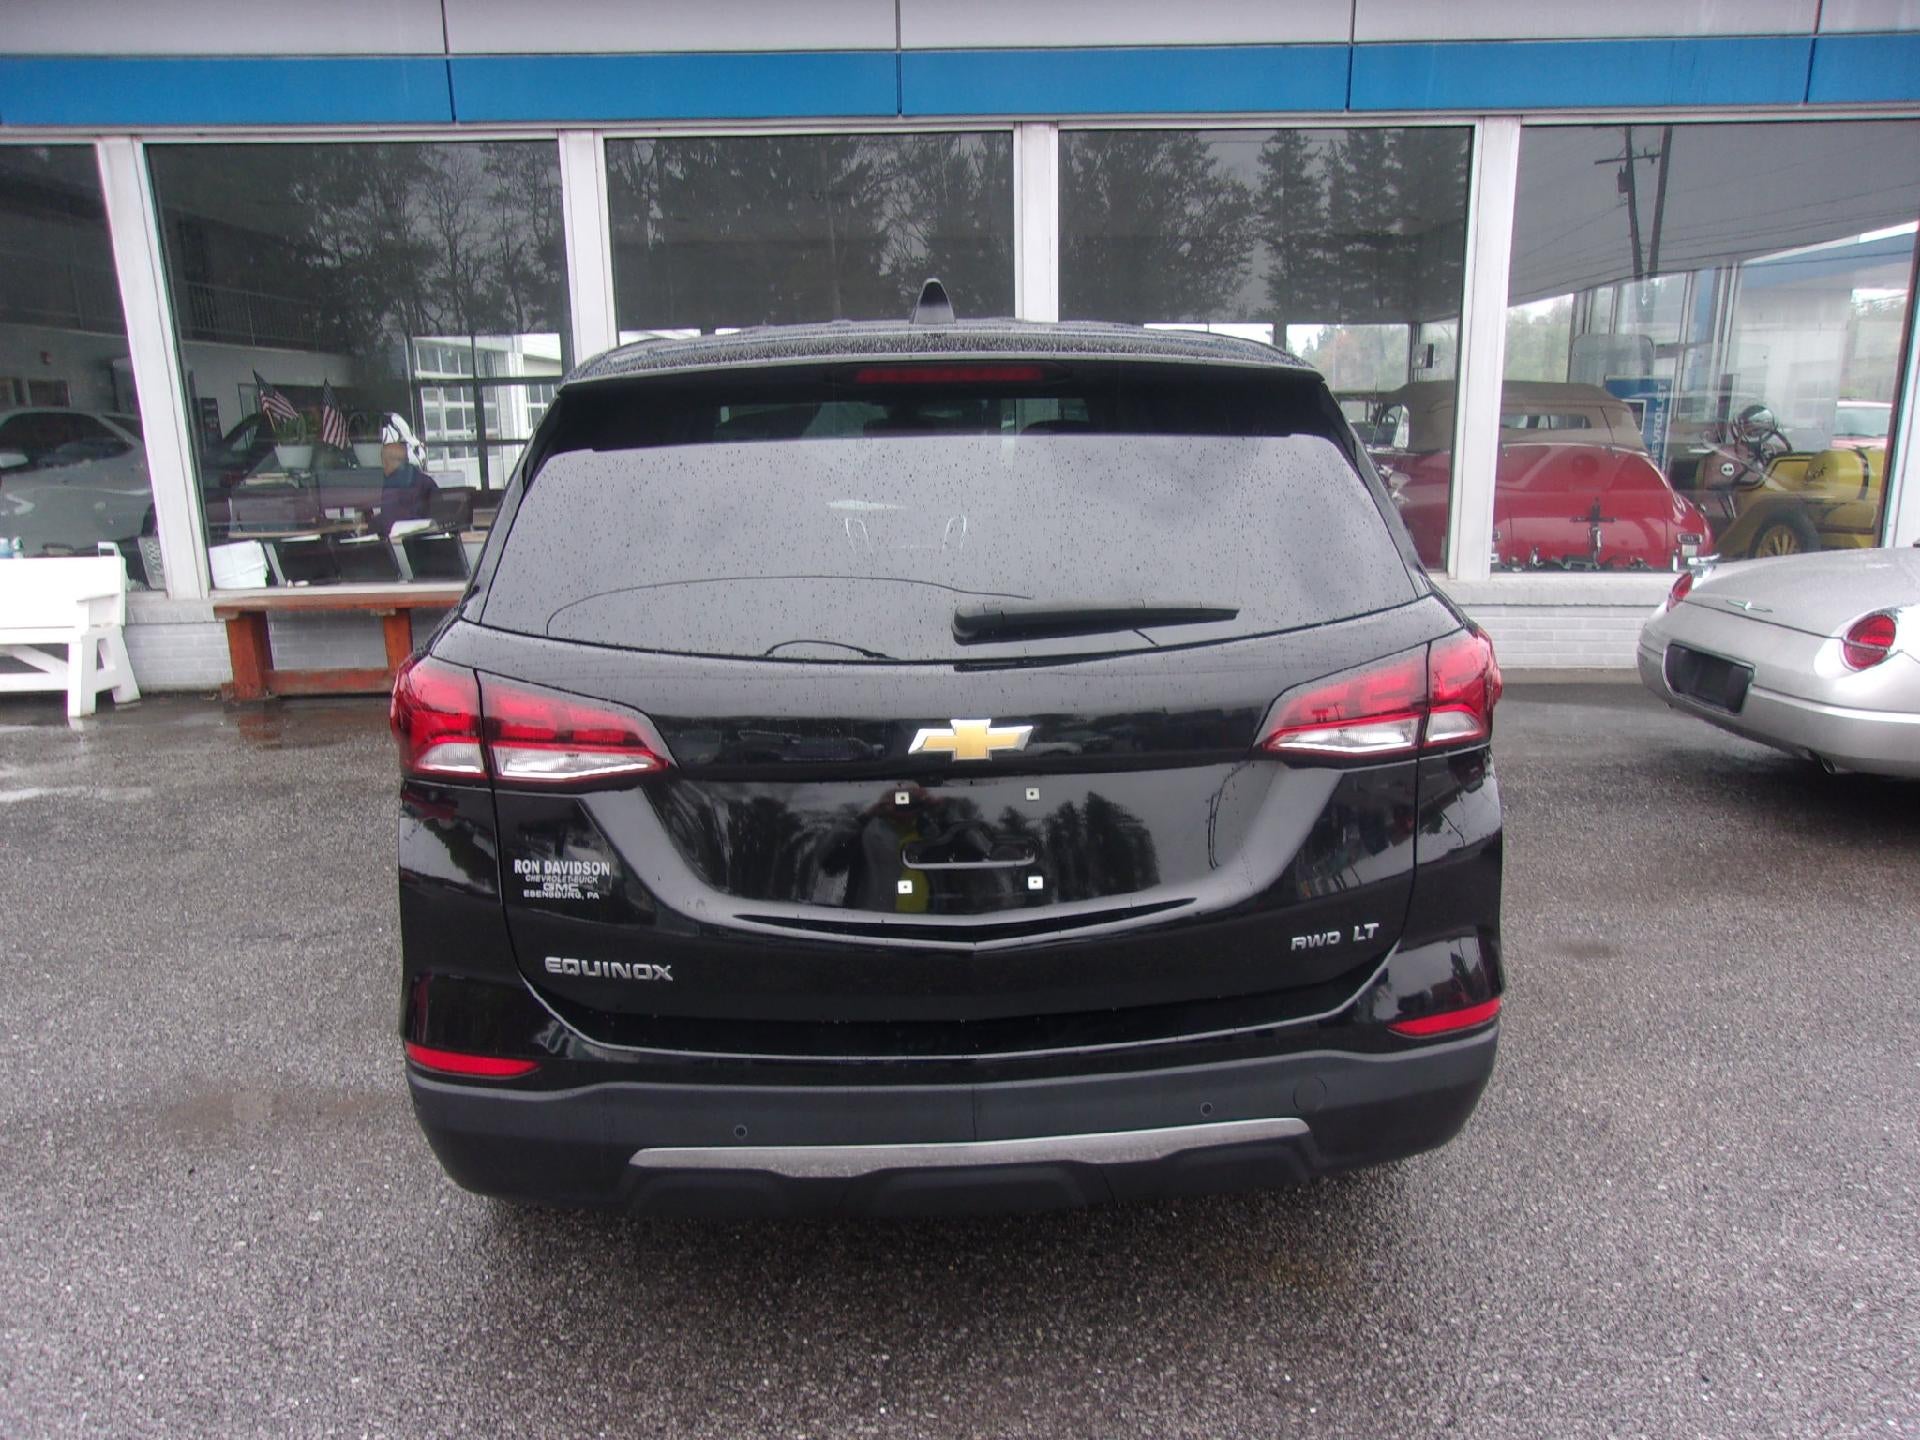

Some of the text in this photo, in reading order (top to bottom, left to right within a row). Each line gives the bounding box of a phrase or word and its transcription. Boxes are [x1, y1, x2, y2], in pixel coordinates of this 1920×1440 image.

[514, 859, 610, 876] RON DAVIDSON
[543, 882, 579, 892] GMC
[587, 891, 600, 900] PA
[1291, 923, 1380, 951] AWD LT
[545, 956, 673, 981] EQUINOX
